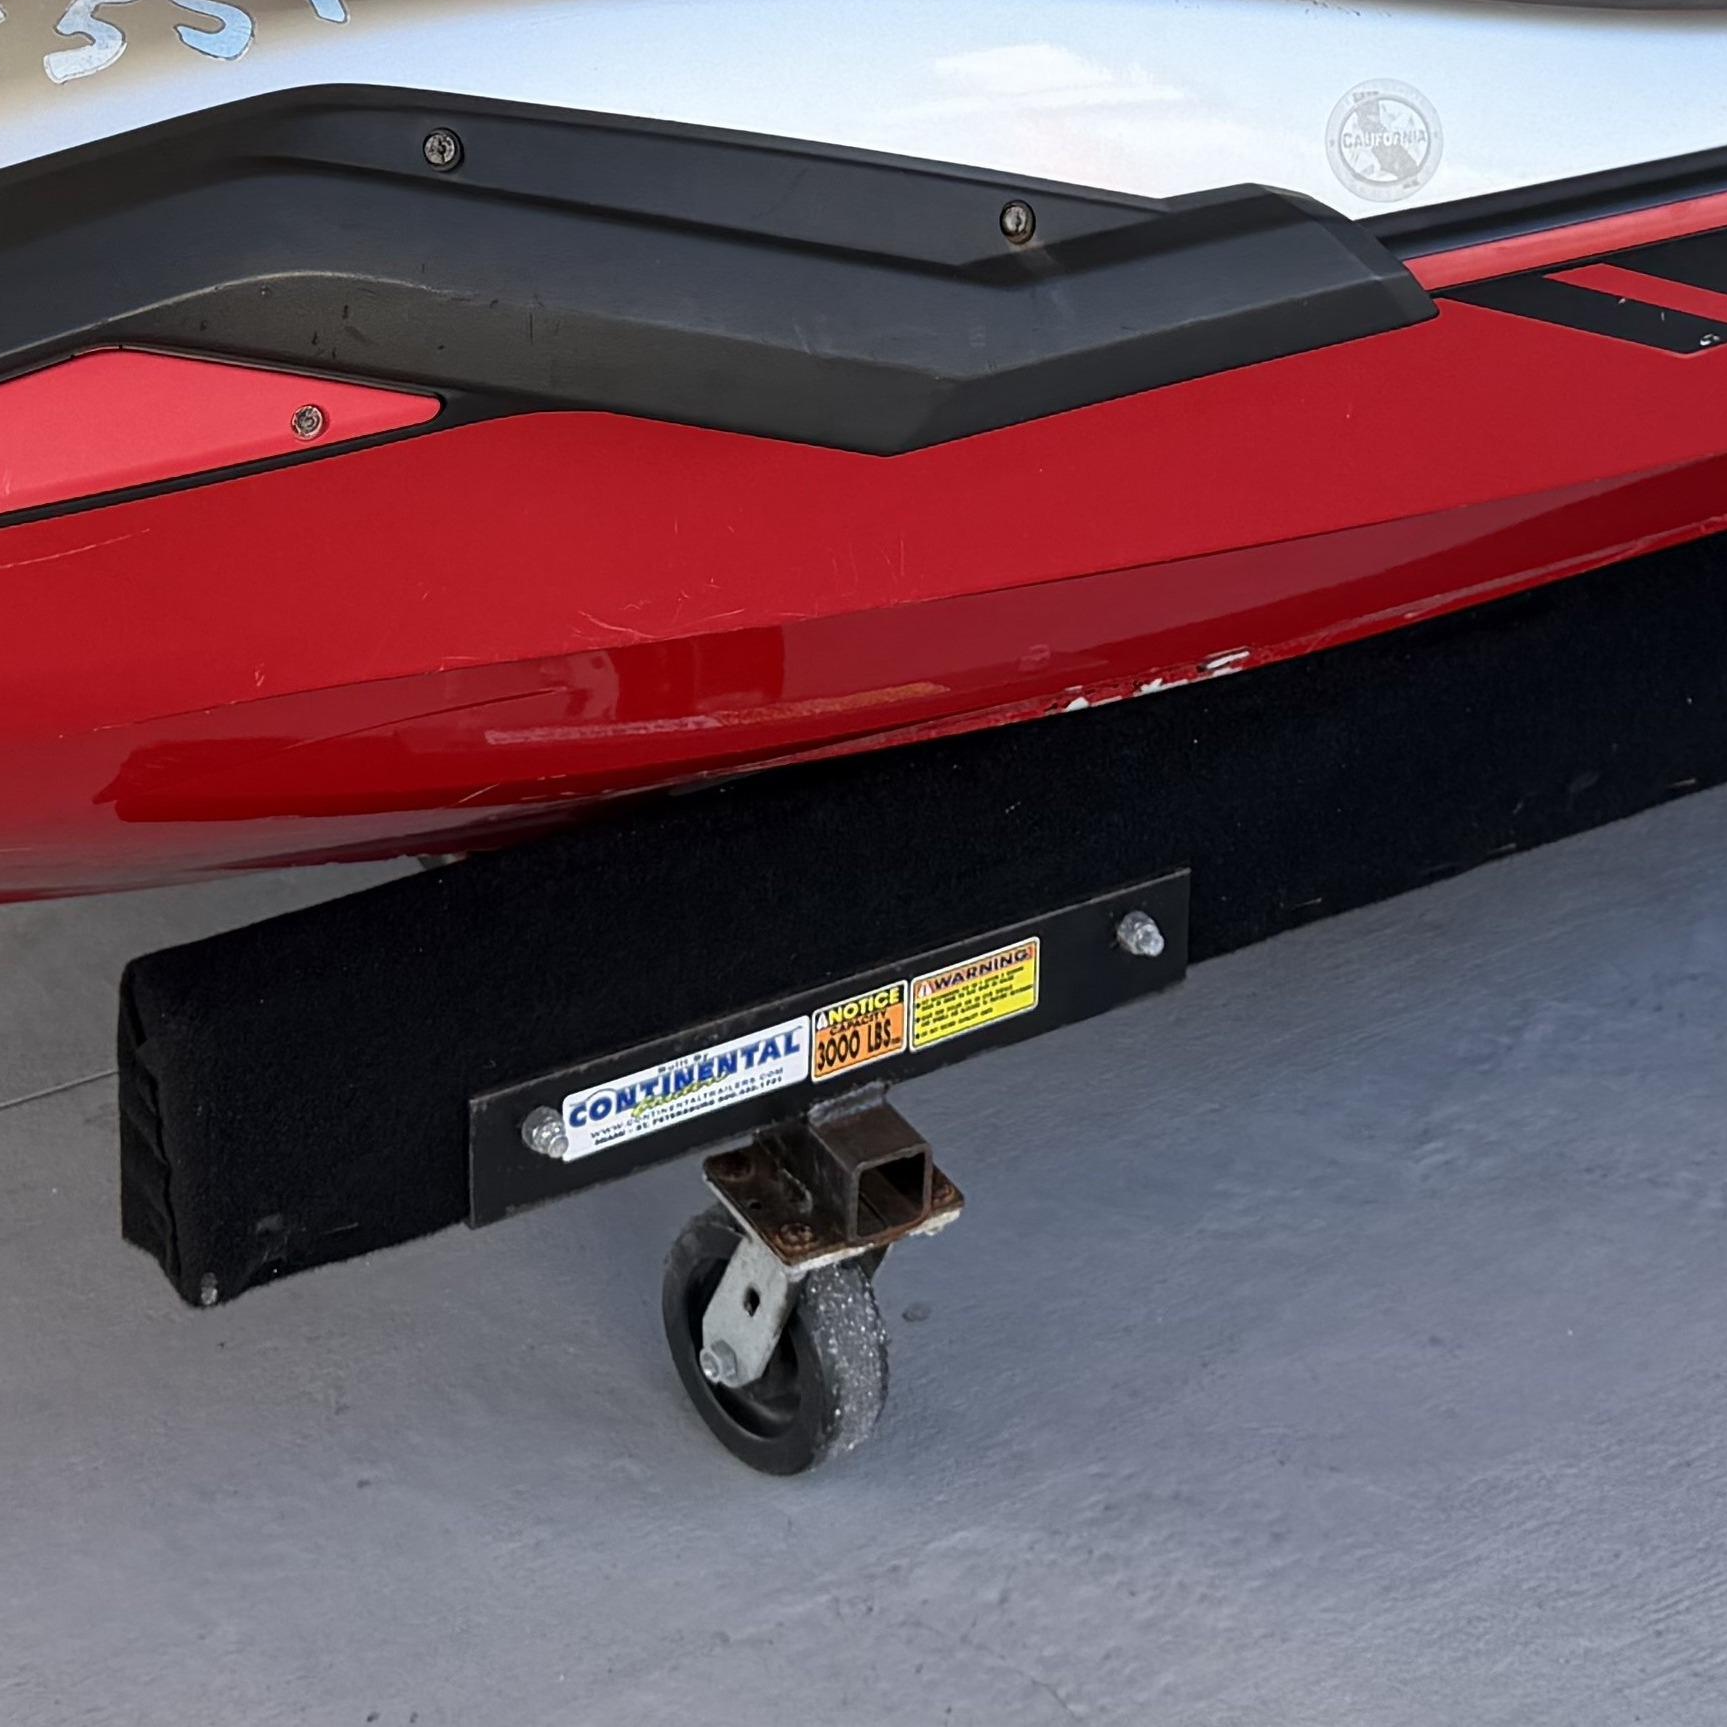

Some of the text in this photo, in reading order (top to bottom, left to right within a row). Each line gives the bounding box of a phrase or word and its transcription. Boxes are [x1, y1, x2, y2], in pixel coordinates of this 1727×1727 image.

[1342, 129, 1427, 149] CALIFORNIA
[828, 986, 900, 1026] NOTICE
[817, 1029, 861, 1072] 3000
[569, 1030, 800, 1128] CONTINENTAL
